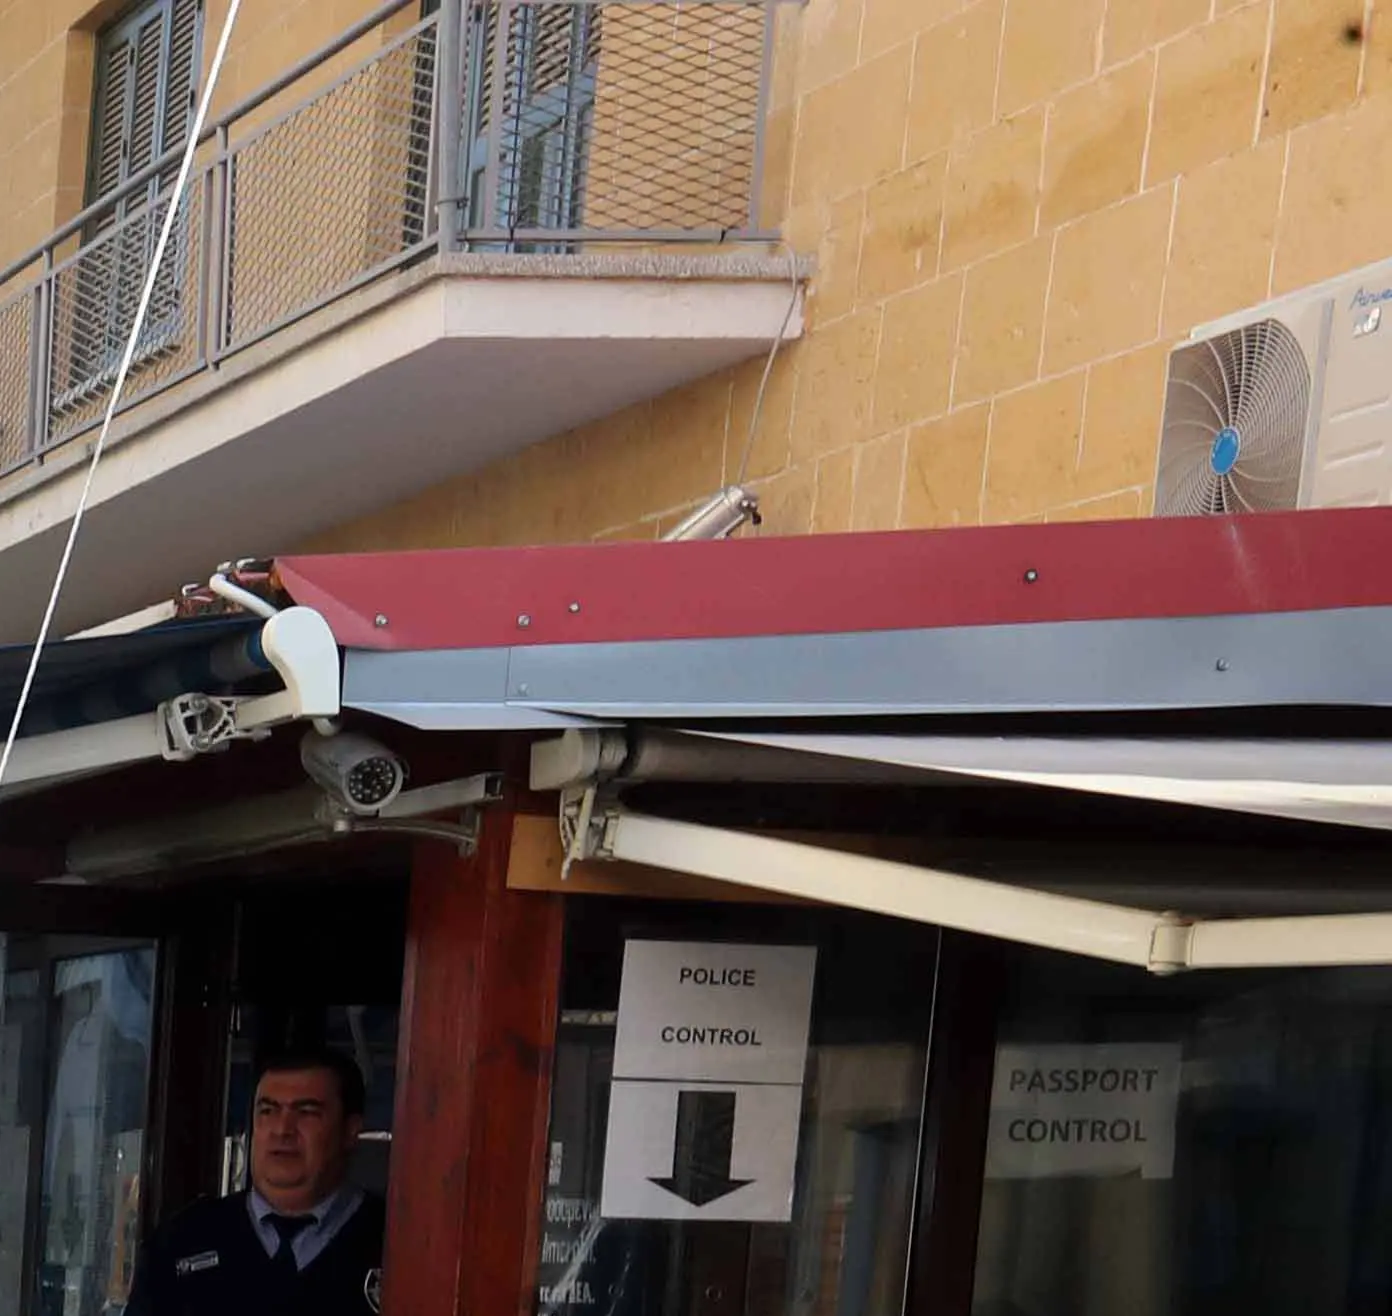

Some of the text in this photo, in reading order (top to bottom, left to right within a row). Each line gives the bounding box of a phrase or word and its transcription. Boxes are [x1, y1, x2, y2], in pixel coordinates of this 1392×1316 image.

[679, 967, 756, 986] POLICE
[661, 1026, 762, 1046] CONTROL
[1009, 1068, 1159, 1093] PASSPORT
[1008, 1118, 1147, 1143] CONTROL
